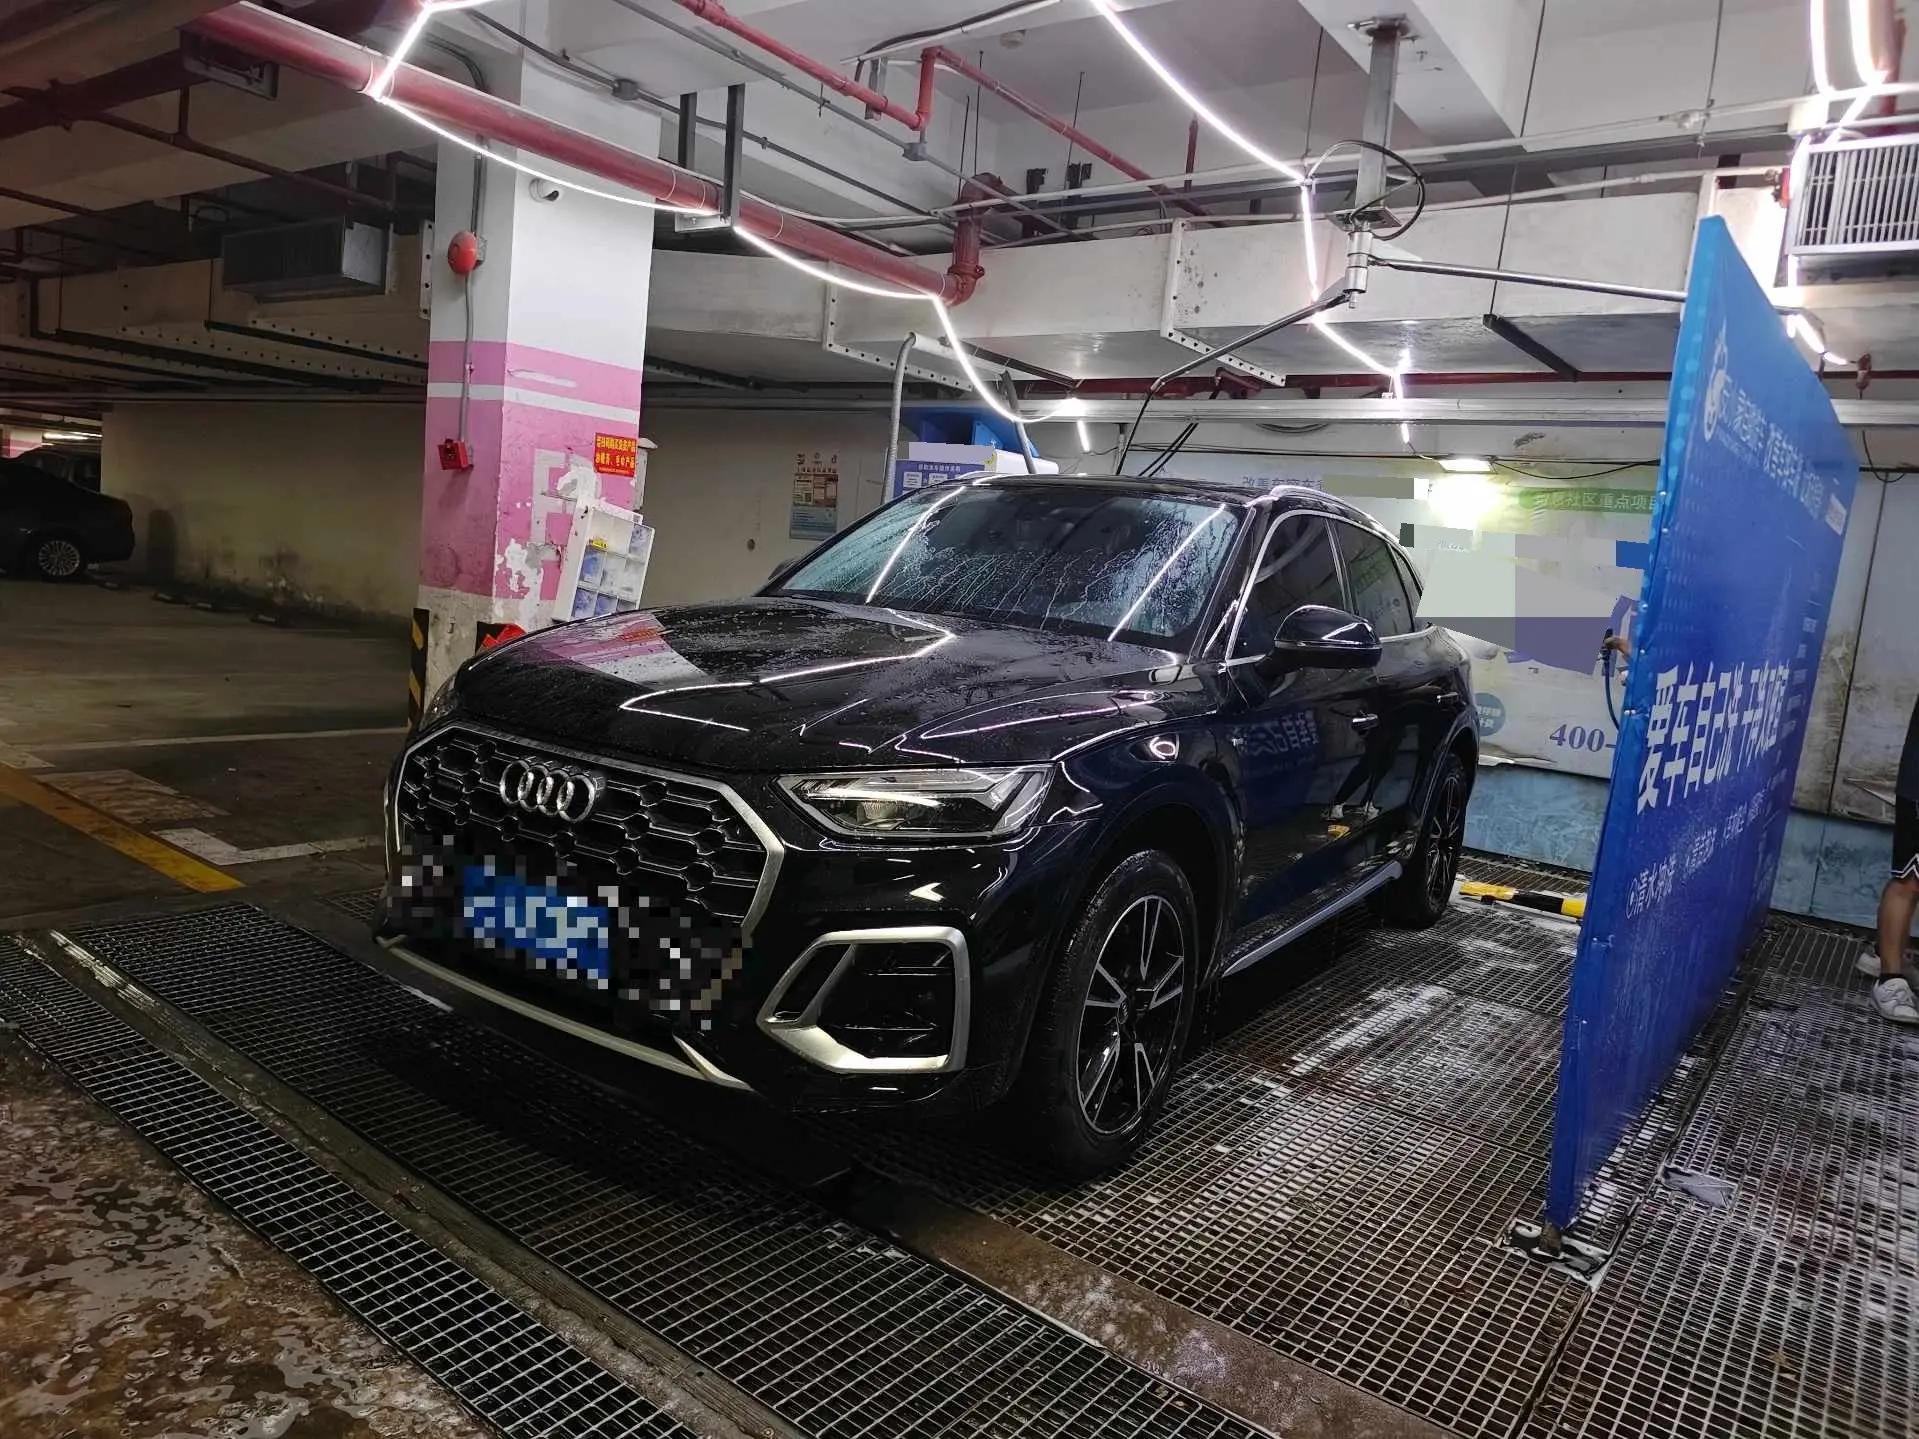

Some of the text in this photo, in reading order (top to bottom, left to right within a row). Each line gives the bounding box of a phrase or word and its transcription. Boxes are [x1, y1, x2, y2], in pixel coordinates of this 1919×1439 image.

[1637, 660, 1745, 816] 爱车自己洗
